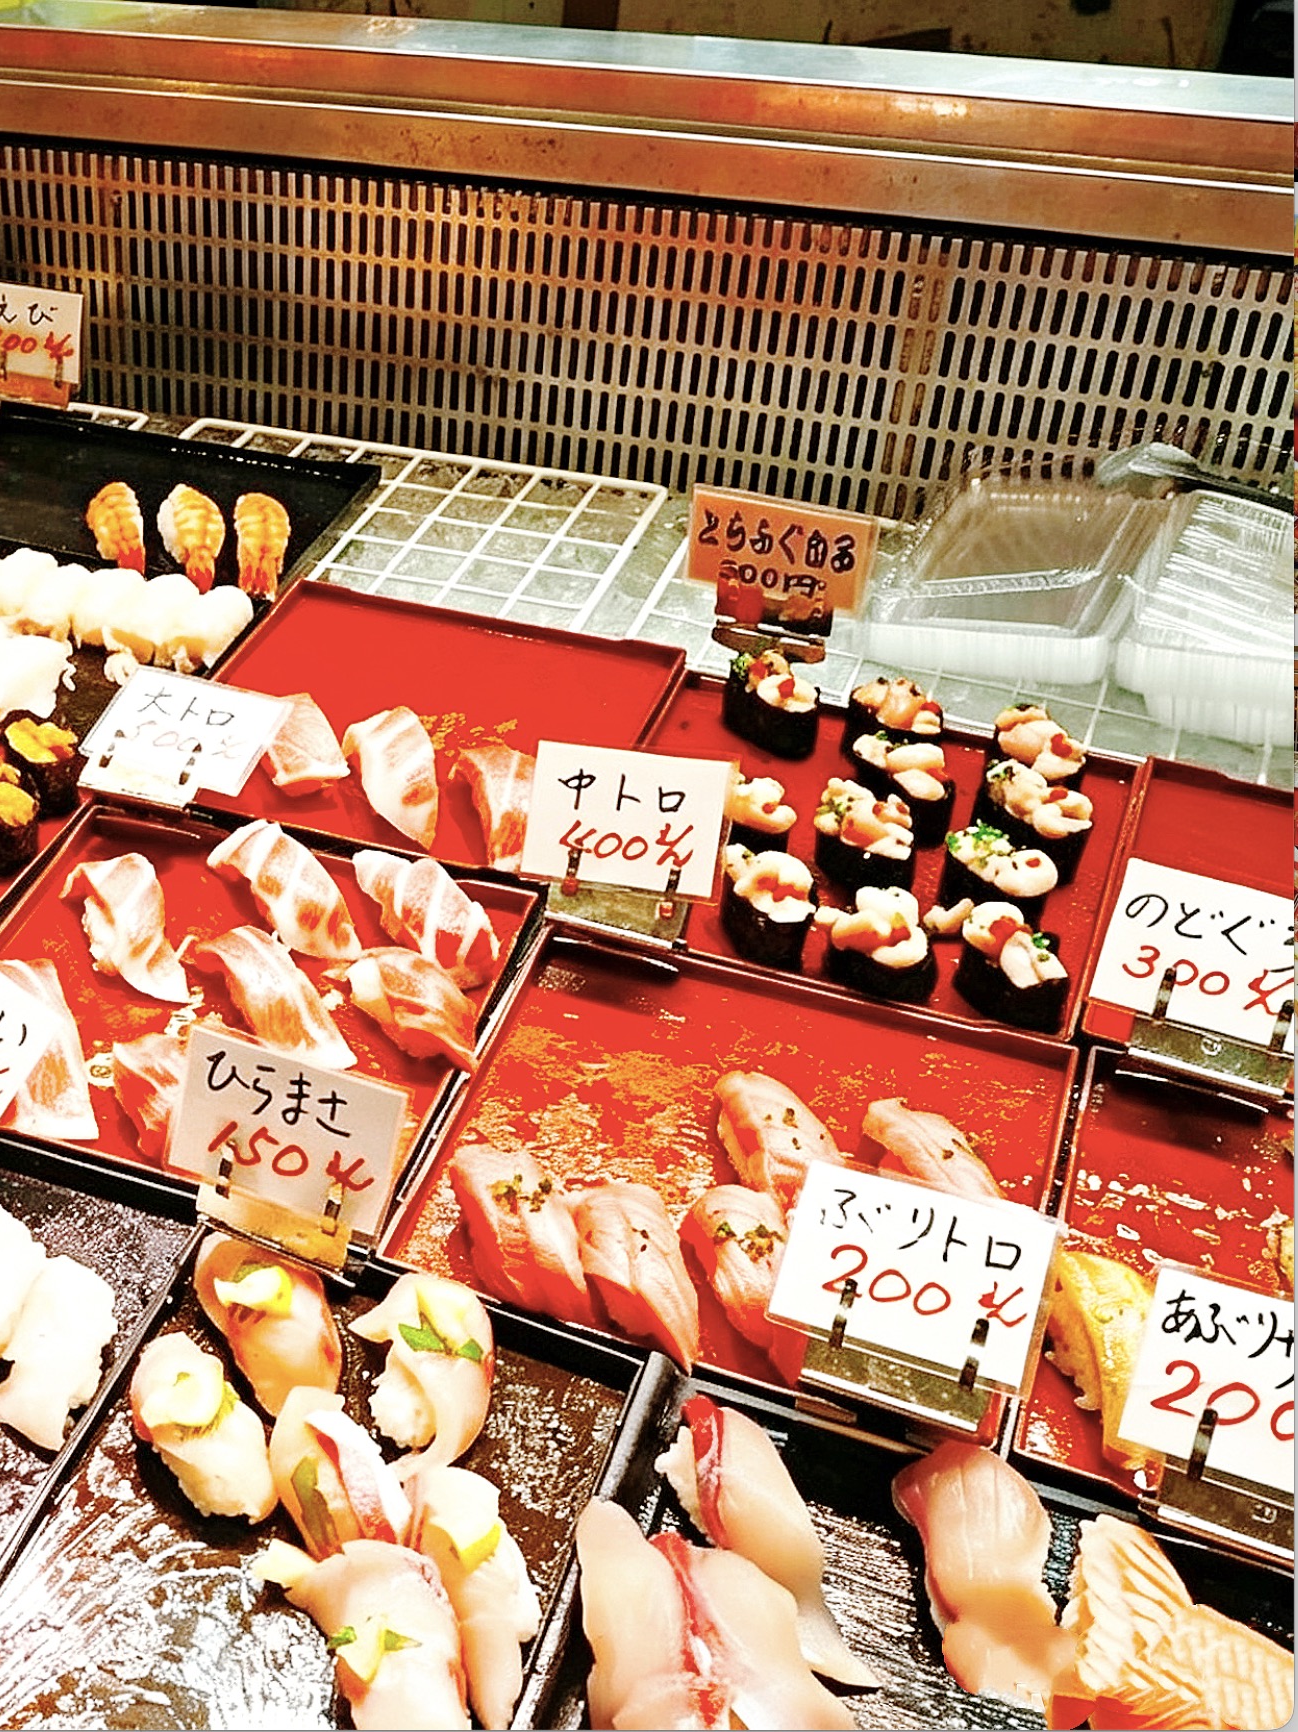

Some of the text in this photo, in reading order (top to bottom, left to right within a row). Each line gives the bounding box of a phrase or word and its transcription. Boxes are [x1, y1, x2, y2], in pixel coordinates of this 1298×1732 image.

[136, 686, 236, 727] 大トロ
[557, 768, 687, 813] 中トロ
[206, 1050, 352, 1138] ひらまさ
[819, 1188, 1022, 1271] ぶりトロ
